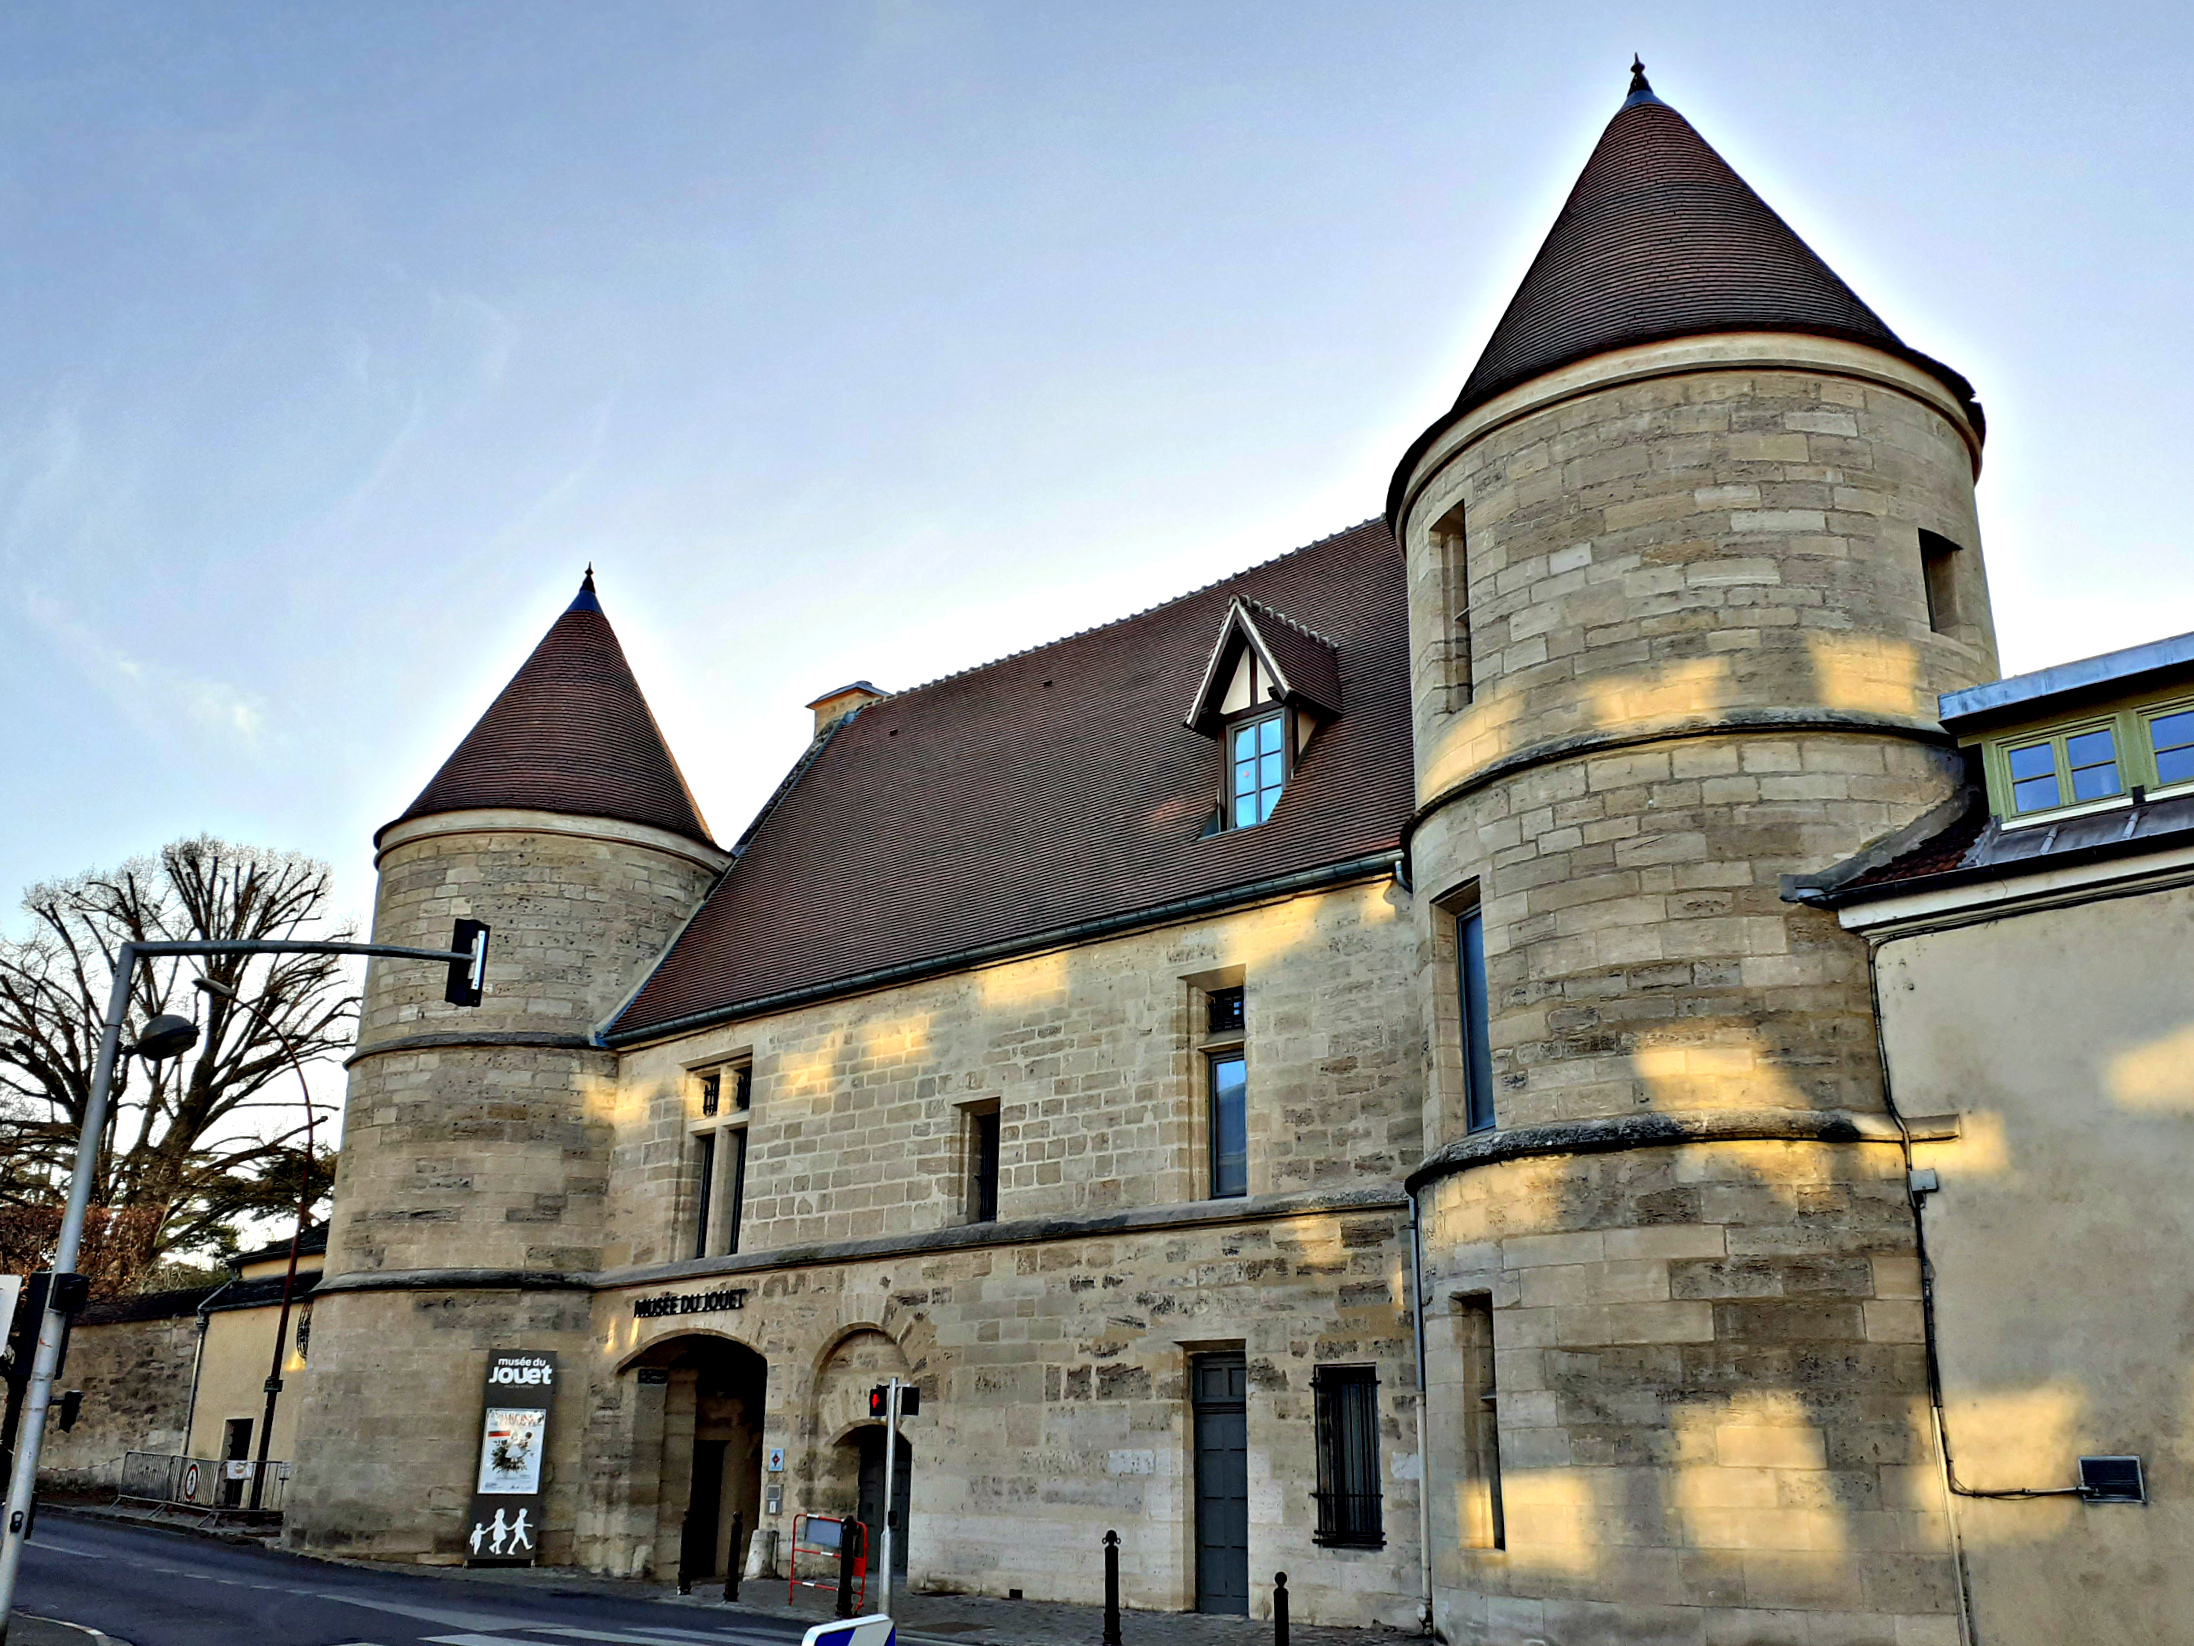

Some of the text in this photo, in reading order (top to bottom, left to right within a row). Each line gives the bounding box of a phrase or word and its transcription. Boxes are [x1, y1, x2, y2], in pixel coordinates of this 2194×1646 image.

[634, 1288, 747, 1318] MUSÉE DU JOUET
[498, 1356, 546, 1367] musée du
[488, 1365, 553, 1385] Jouet
